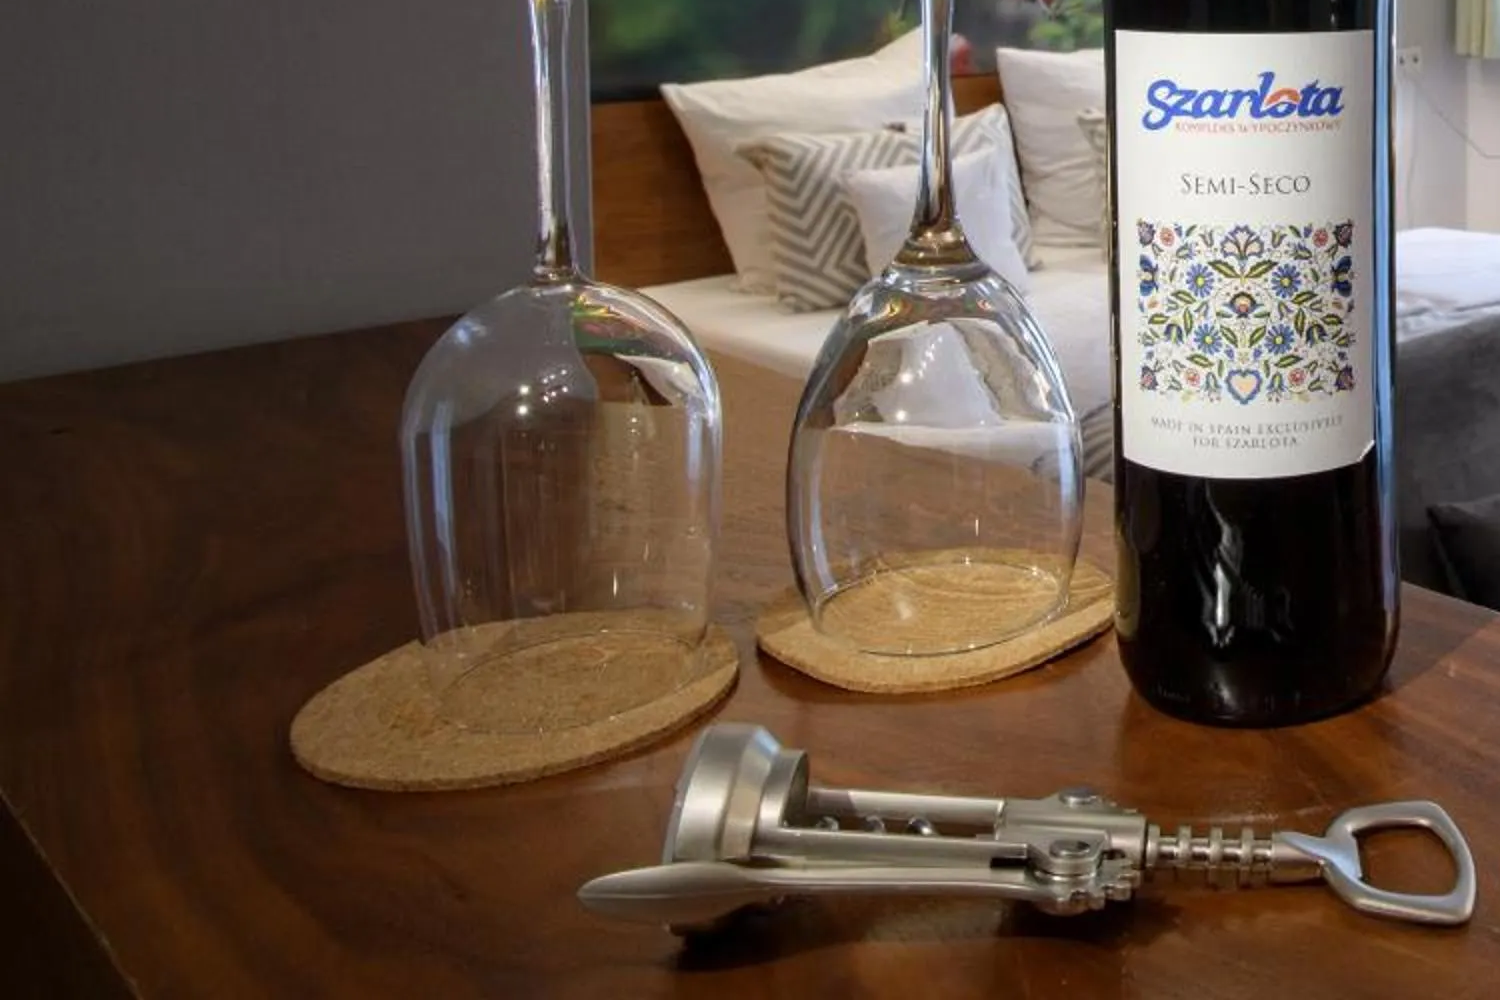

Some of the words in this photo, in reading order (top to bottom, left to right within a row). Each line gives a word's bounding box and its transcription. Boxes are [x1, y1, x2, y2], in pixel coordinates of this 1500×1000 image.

[1142, 71, 1344, 130] Szarlota
[1181, 173, 1311, 195] SEMI-SECO
[1151, 416, 1183, 432] MADE
[1189, 421, 1204, 434] IN
[1210, 423, 1250, 435] SPAIN
[1257, 414, 1343, 434] EXCLUSIVELY
[1194, 437, 1220, 448] FOR
[1226, 436, 1299, 449] SZARLOTA
